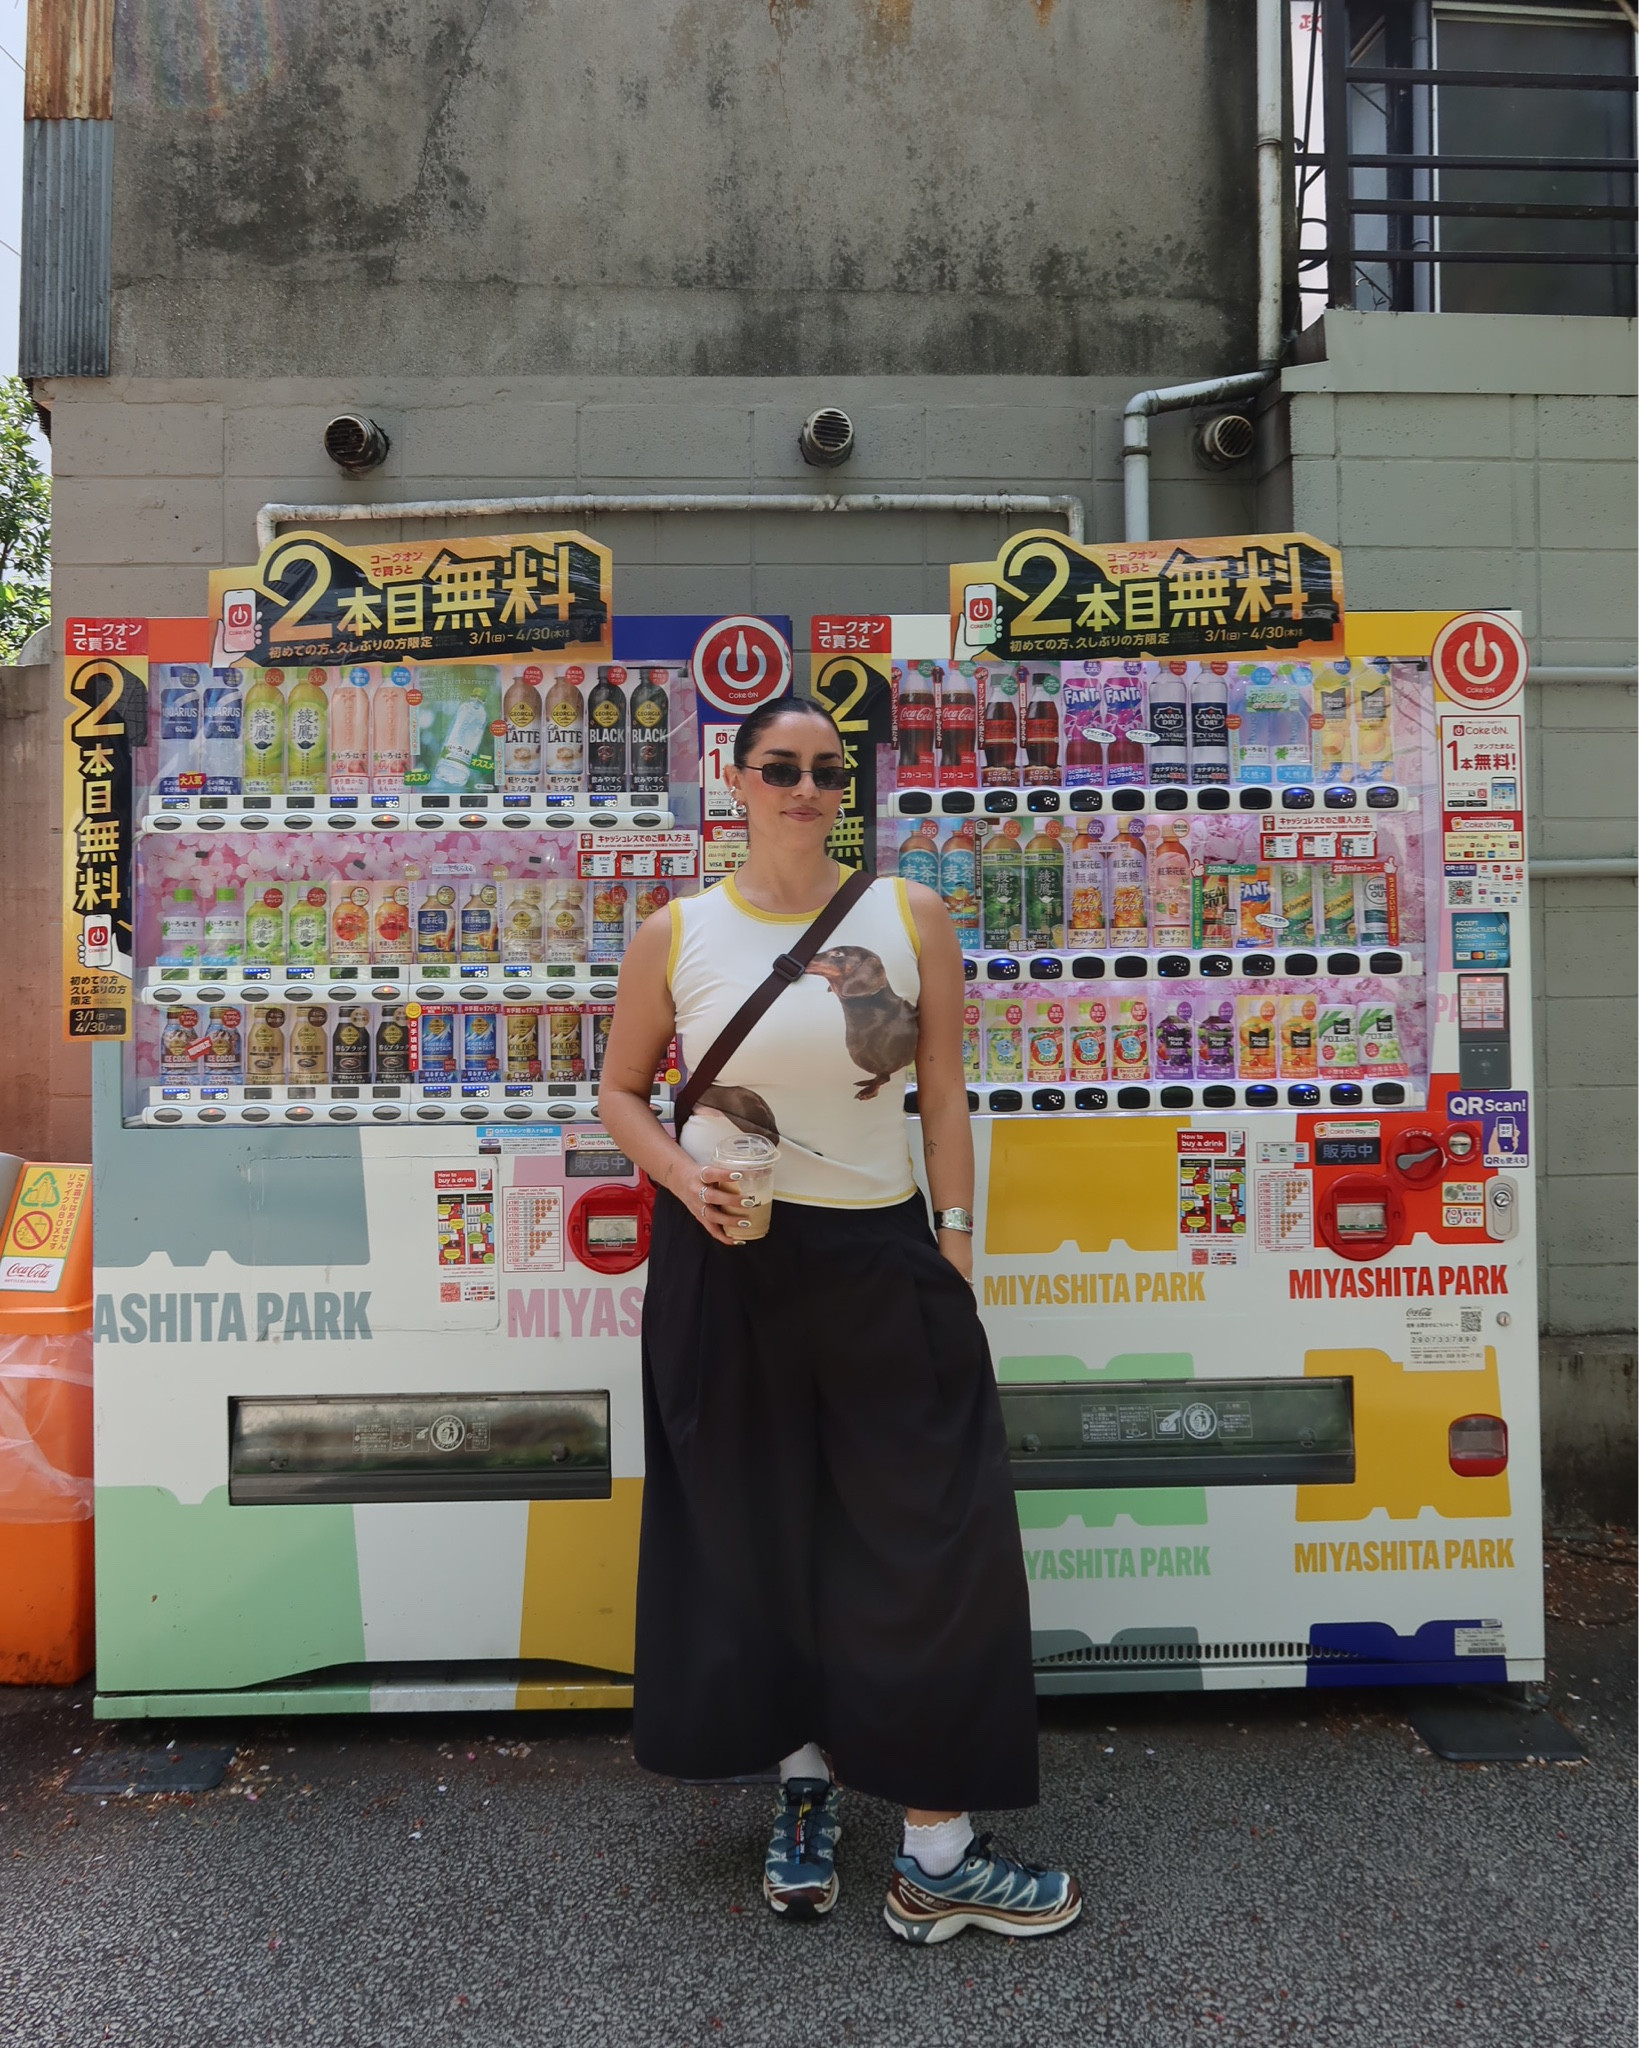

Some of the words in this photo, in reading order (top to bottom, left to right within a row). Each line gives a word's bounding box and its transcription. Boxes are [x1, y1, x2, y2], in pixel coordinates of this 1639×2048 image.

[370, 551, 423, 565] コークオン
[1107, 551, 1158, 563] コークオン
[372, 564, 414, 577] で買うと
[1109, 563, 1150, 575] で買うと
[73, 623, 142, 636] コークオン
[818, 622, 885, 634] コークオン
[73, 638, 127, 650] で買うと
[268, 636, 433, 659] 初めての方、久しぶりの方限定
[819, 635, 871, 649] で買うと
[1009, 632, 1170, 654] 初めての方、久しぶりの方限定
[1065, 687, 1100, 704] FANTA
[1105, 687, 1141, 704] FANTA
[901, 706, 934, 721] Coca-Cola
[943, 706, 975, 721] Coca-Cola
[254, 709, 271, 741] 綾鷹
[297, 709, 315, 740] 綾鷹
[1466, 727, 1490, 735] Coke
[506, 730, 540, 744] LATTE
[548, 730, 583, 744] LATTE
[590, 728, 625, 743] BLACK
[632, 728, 667, 743] BLACK
[1447, 740, 1517, 771] 1本無料!
[179, 775, 203, 786] 大人気
[1279, 815, 1370, 825] キャッシュレスでのご購入方法
[1498, 822, 1512, 830] Pay
[598, 833, 691, 842] キャッシュレスでのご購入方法
[726, 831, 746, 839] Coke
[1072, 860, 1101, 869] 紅茶花伝
[1113, 860, 1142, 868] 紅茶花伝
[1075, 872, 1099, 884] 無糖
[1116, 872, 1140, 883] 無糖
[1157, 867, 1187, 876] 紅茶花伝
[70, 976, 118, 986] 初めての方
[70, 985, 126, 995] 久しぶりの方
[70, 996, 92, 1005] 限定
[1450, 1096, 1485, 1116] QR
[1484, 1098, 1527, 1112] Scan!
[1355, 1128, 1367, 1136] Pay
[1322, 1143, 1374, 1159] 販売中
[574, 1155, 627, 1171] 販売中
[1485, 1156, 1526, 1165] QRも使える
[49, 1172, 77, 1250] リサイクルBOXです
[6, 1262, 54, 1279] Coca-Cola
[983, 1273, 1130, 1306] MIYASHITA
[1135, 1271, 1206, 1303] PARK
[1290, 1265, 1435, 1299] MIYASHITA
[1438, 1264, 1509, 1295] PARK
[93, 1292, 248, 1344] ASHITA
[256, 1290, 374, 1342] PARK
[1406, 1307, 1432, 1317] Coca-Cola
[1140, 1545, 1211, 1577] PARK
[1293, 1539, 1441, 1574] MIYASHITA
[1444, 1537, 1515, 1570] PARK
